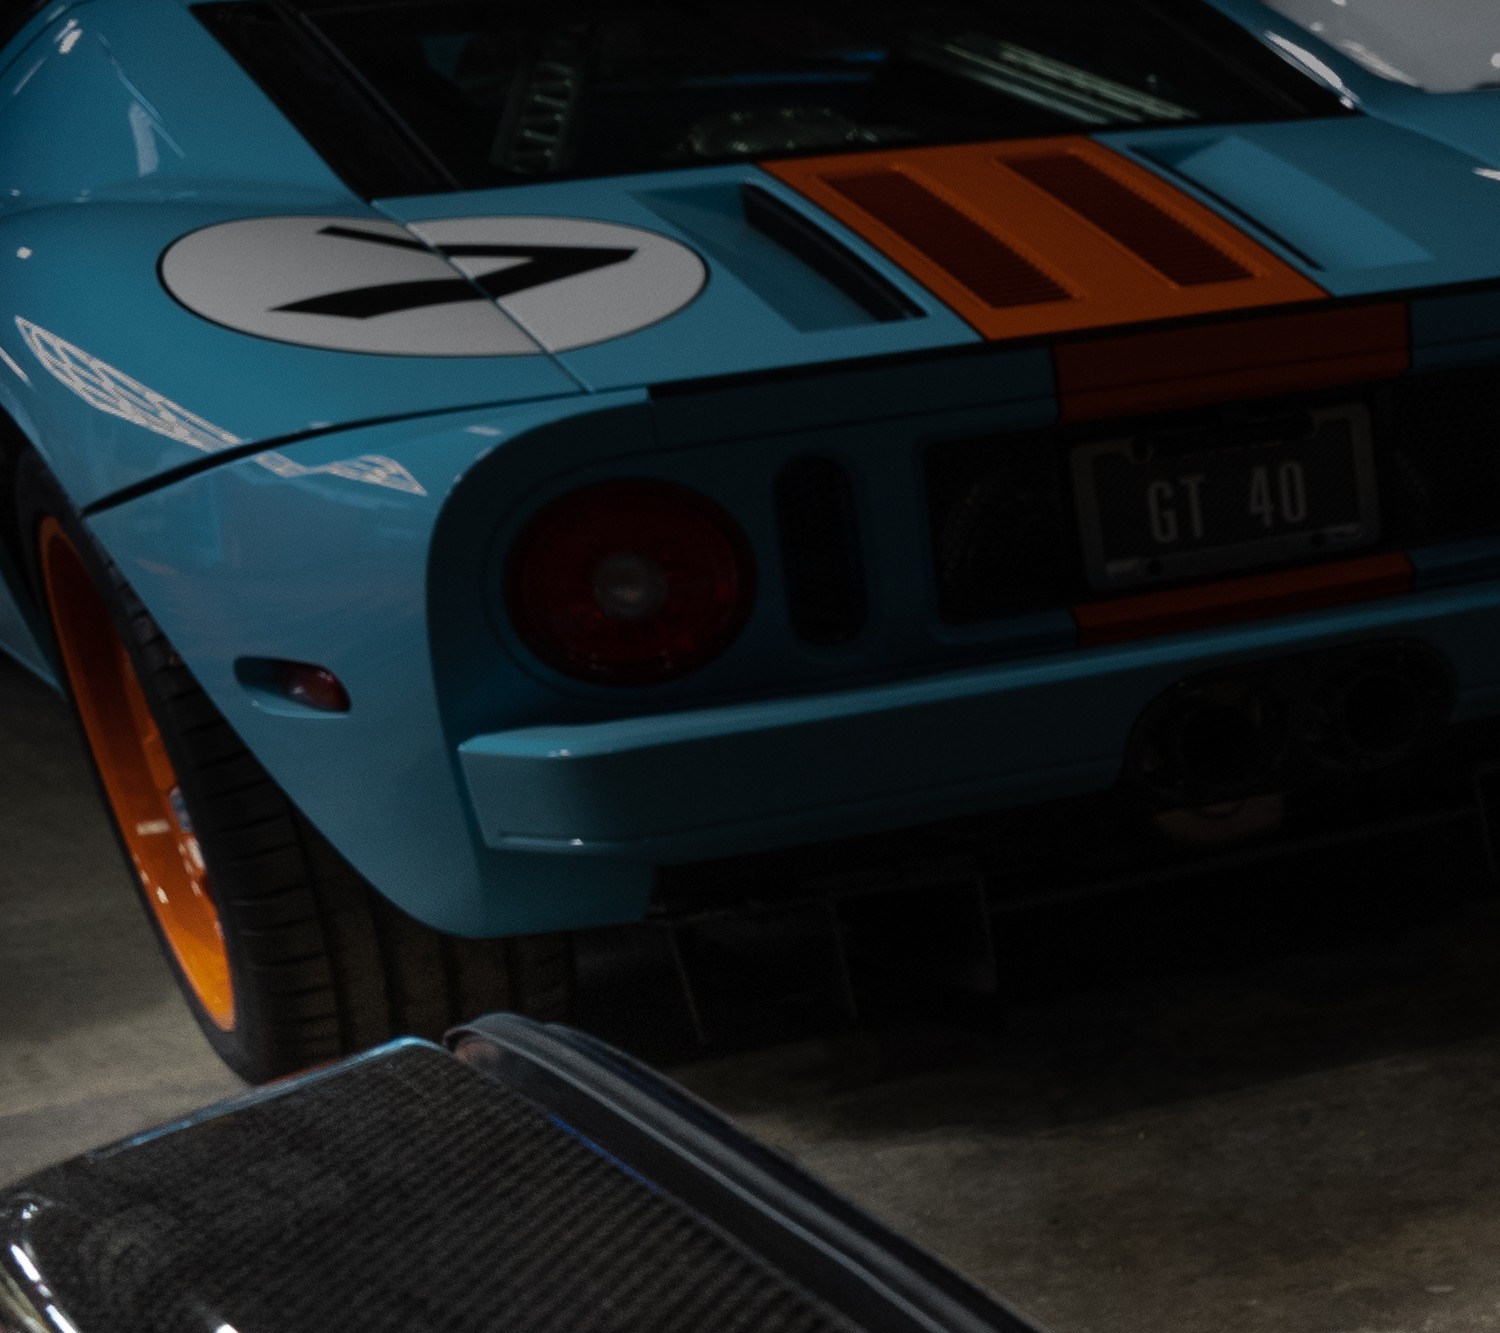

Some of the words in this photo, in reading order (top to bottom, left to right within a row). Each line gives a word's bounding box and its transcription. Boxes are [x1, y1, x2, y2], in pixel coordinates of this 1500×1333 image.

[270, 225, 637, 319] 7
[1146, 474, 1206, 544] GT
[1248, 461, 1308, 528] 40
